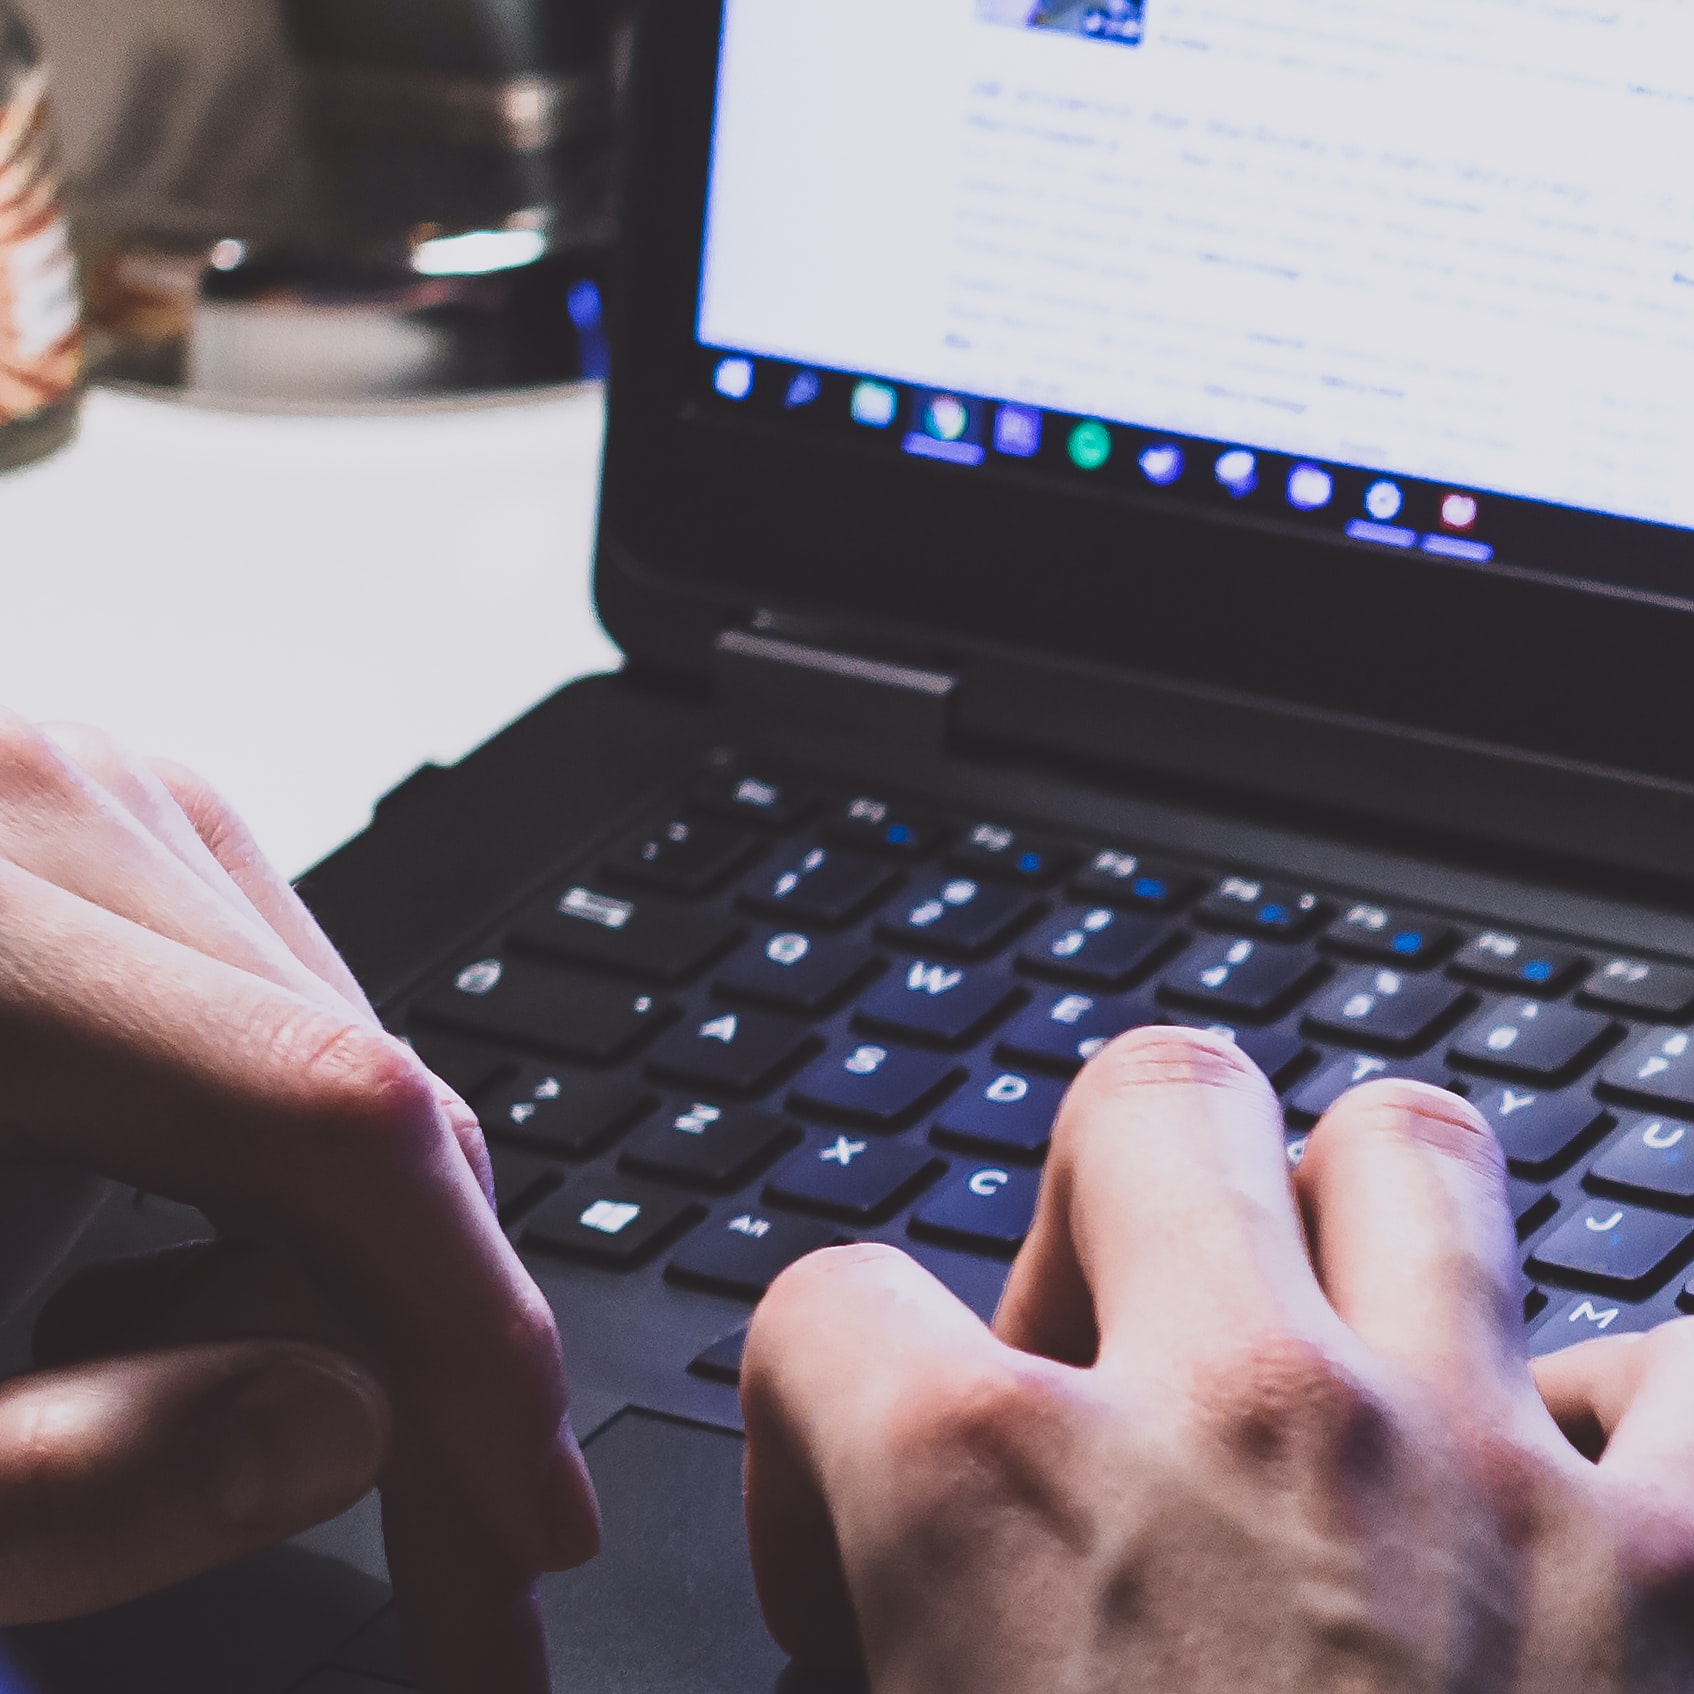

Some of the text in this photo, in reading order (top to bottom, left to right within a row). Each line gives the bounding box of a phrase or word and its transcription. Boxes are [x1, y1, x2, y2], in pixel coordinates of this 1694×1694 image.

[907, 961, 962, 994] W
[701, 1015, 737, 1042] A
[845, 1046, 886, 1073] S
[985, 1074, 1028, 1102] D
[1498, 1089, 1535, 1116] Y
[1640, 1121, 1685, 1149] U
[820, 1136, 866, 1165] X
[969, 1170, 1008, 1196] C
[1585, 1211, 1623, 1232] J
[1568, 1300, 1619, 1329] M
